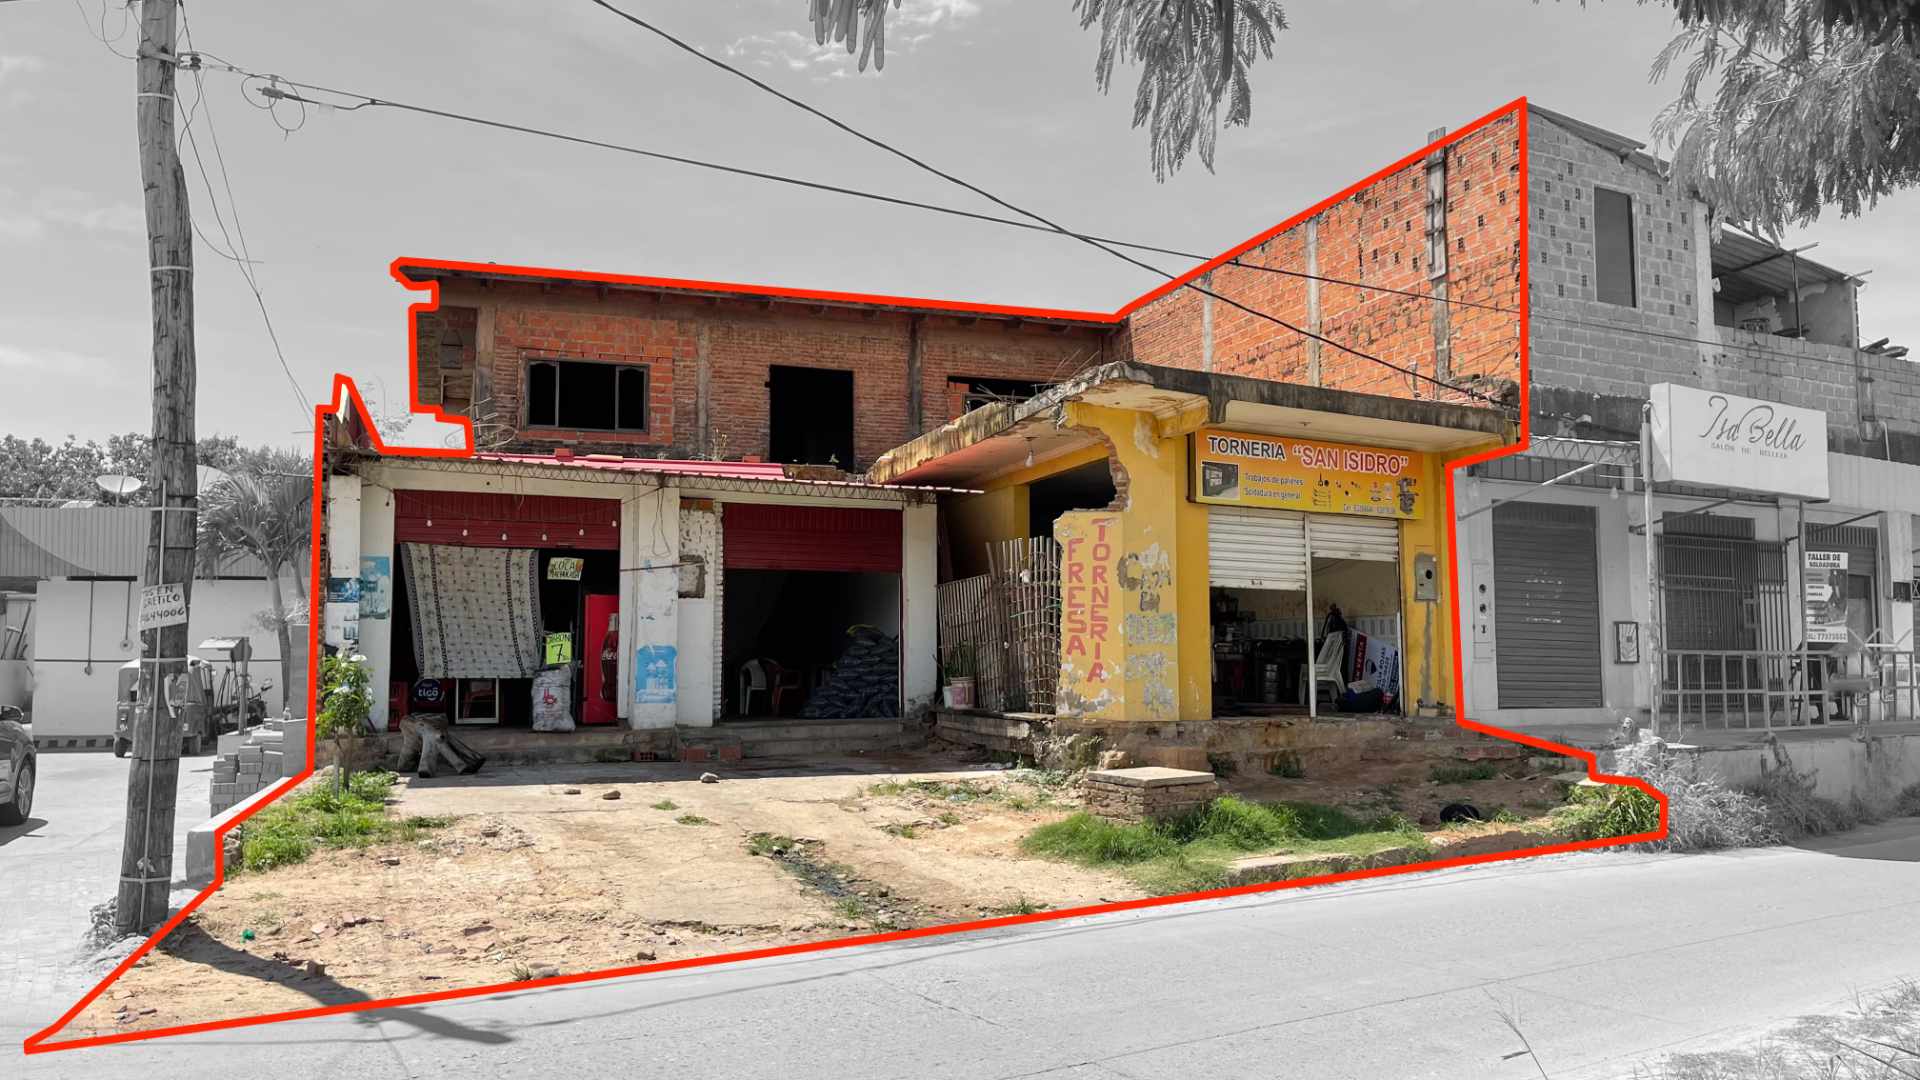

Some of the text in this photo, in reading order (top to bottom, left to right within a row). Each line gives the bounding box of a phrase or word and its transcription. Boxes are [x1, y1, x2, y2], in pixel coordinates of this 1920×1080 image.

[1208, 437, 1286, 460] TORNERIA
[1739, 405, 1807, 452] Bella
[1066, 538, 1087, 656] FRESA
[1087, 518, 1116, 683] TORNERIA
